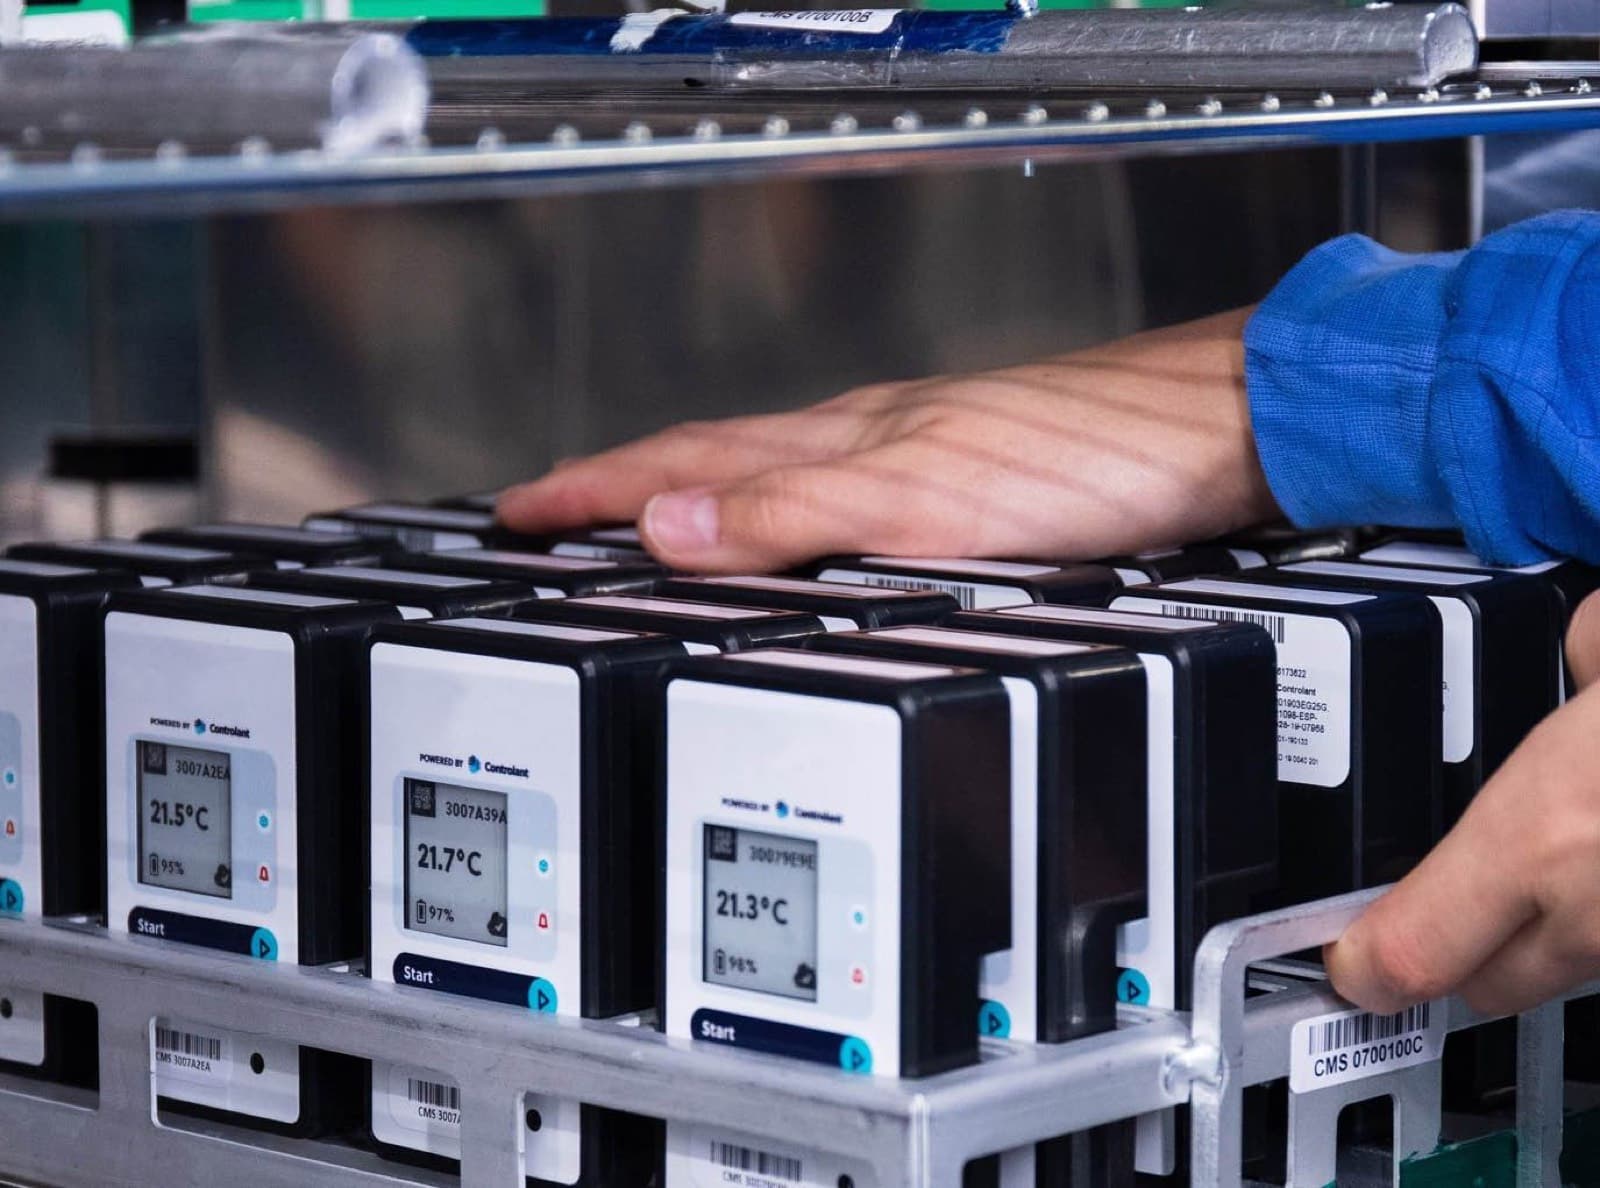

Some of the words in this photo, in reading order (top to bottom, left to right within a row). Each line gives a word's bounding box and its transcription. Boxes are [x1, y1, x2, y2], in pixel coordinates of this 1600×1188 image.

[150, 718, 181, 728] POWERED
[209, 723, 250, 739] Controlant
[175, 760, 230, 780] 3007A2EA
[420, 753, 453, 766] POWERED
[455, 759, 463, 768] BY
[484, 761, 529, 778] Controlant
[150, 799, 208, 831] 21.5°C
[445, 801, 507, 824] 3007A39A
[161, 859, 184, 875] 95%
[418, 843, 482, 876] 21.7°C
[429, 905, 455, 922] 97%
[717, 889, 788, 925] 21.3°C
[137, 918, 165, 936] Start
[404, 965, 433, 984] Start
[702, 1020, 735, 1041] Start
[1314, 1053, 1348, 1076] CMS
[1352, 1035, 1423, 1068] 0700100C
[418, 1106, 436, 1119] CMS
